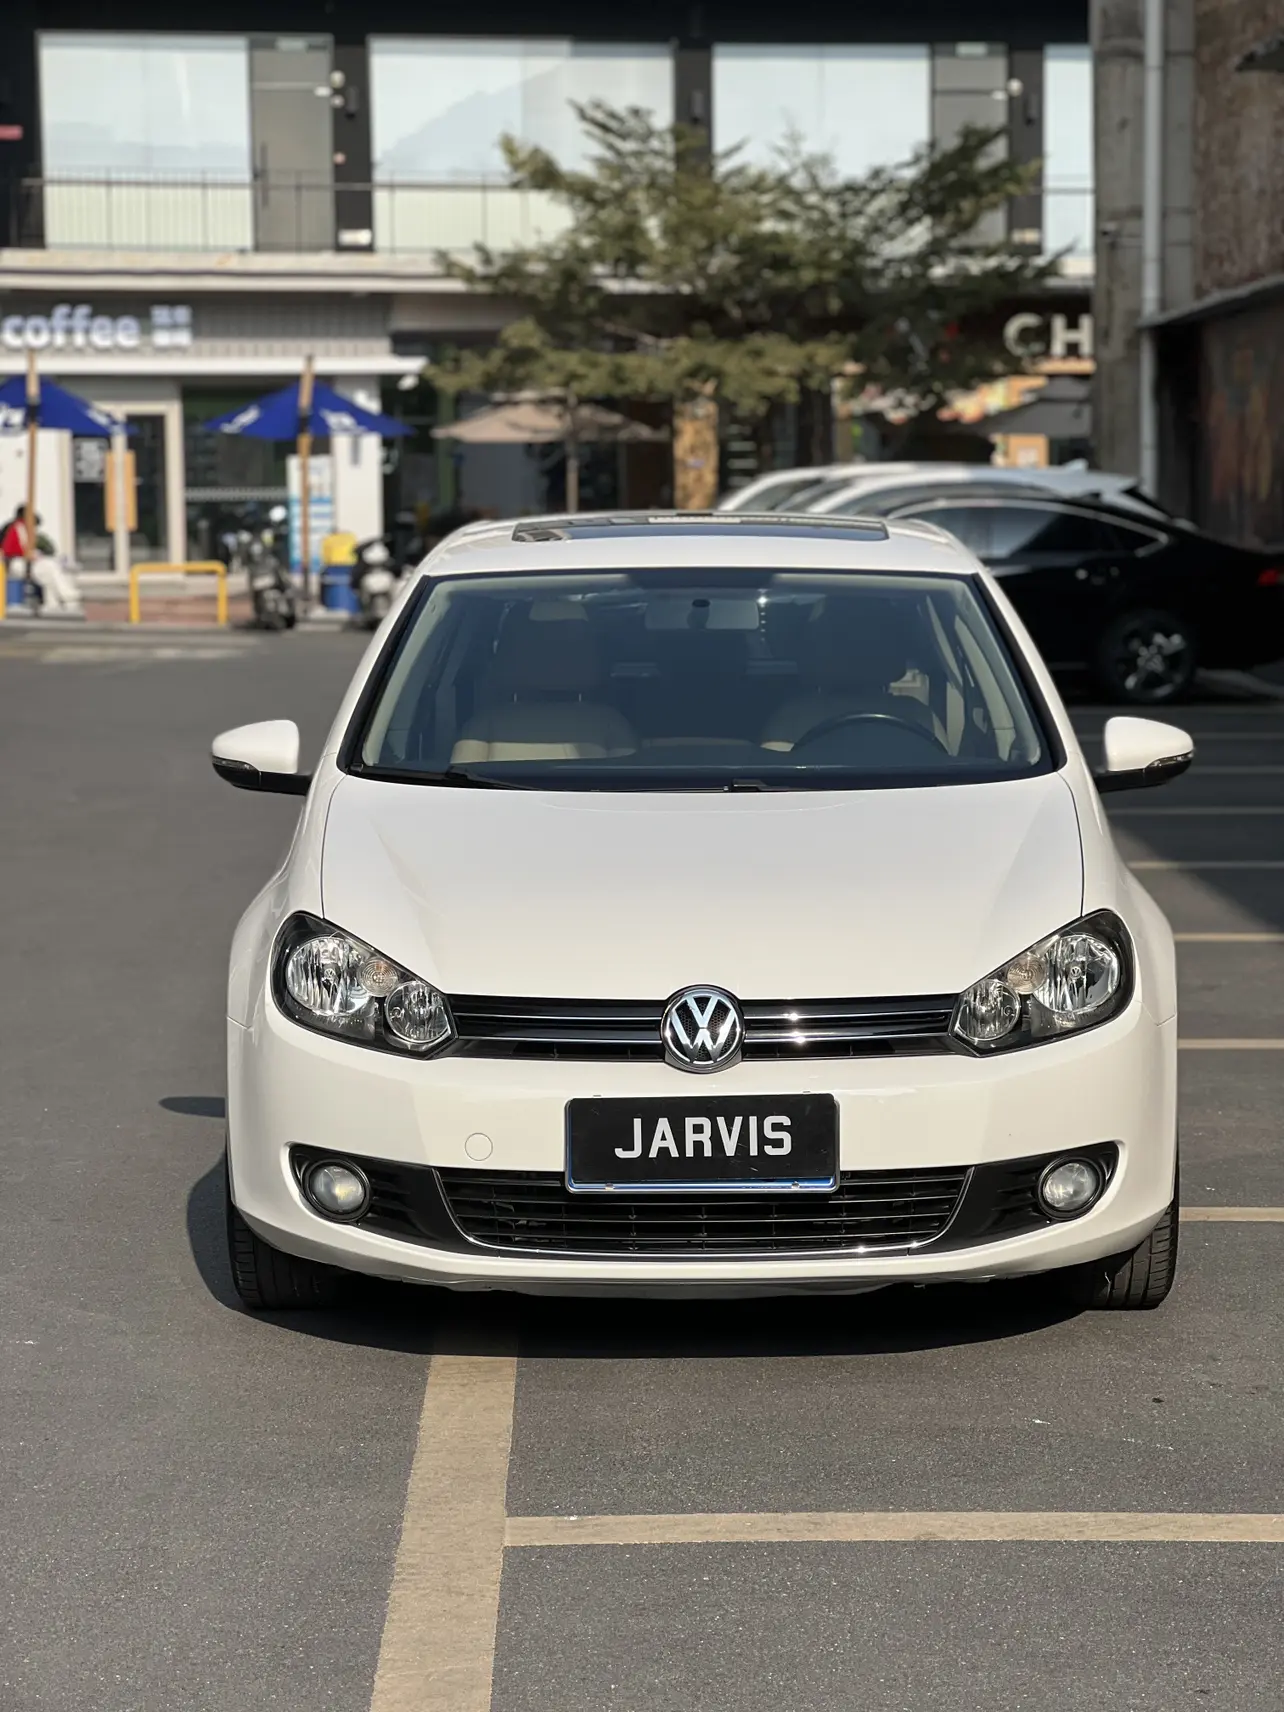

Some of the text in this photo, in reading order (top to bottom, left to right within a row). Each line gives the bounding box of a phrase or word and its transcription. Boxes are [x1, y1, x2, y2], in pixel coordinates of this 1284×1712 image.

[2, 303, 141, 348] coffee
[668, 993, 738, 1064] VW
[615, 1115, 792, 1159] JARVIS
